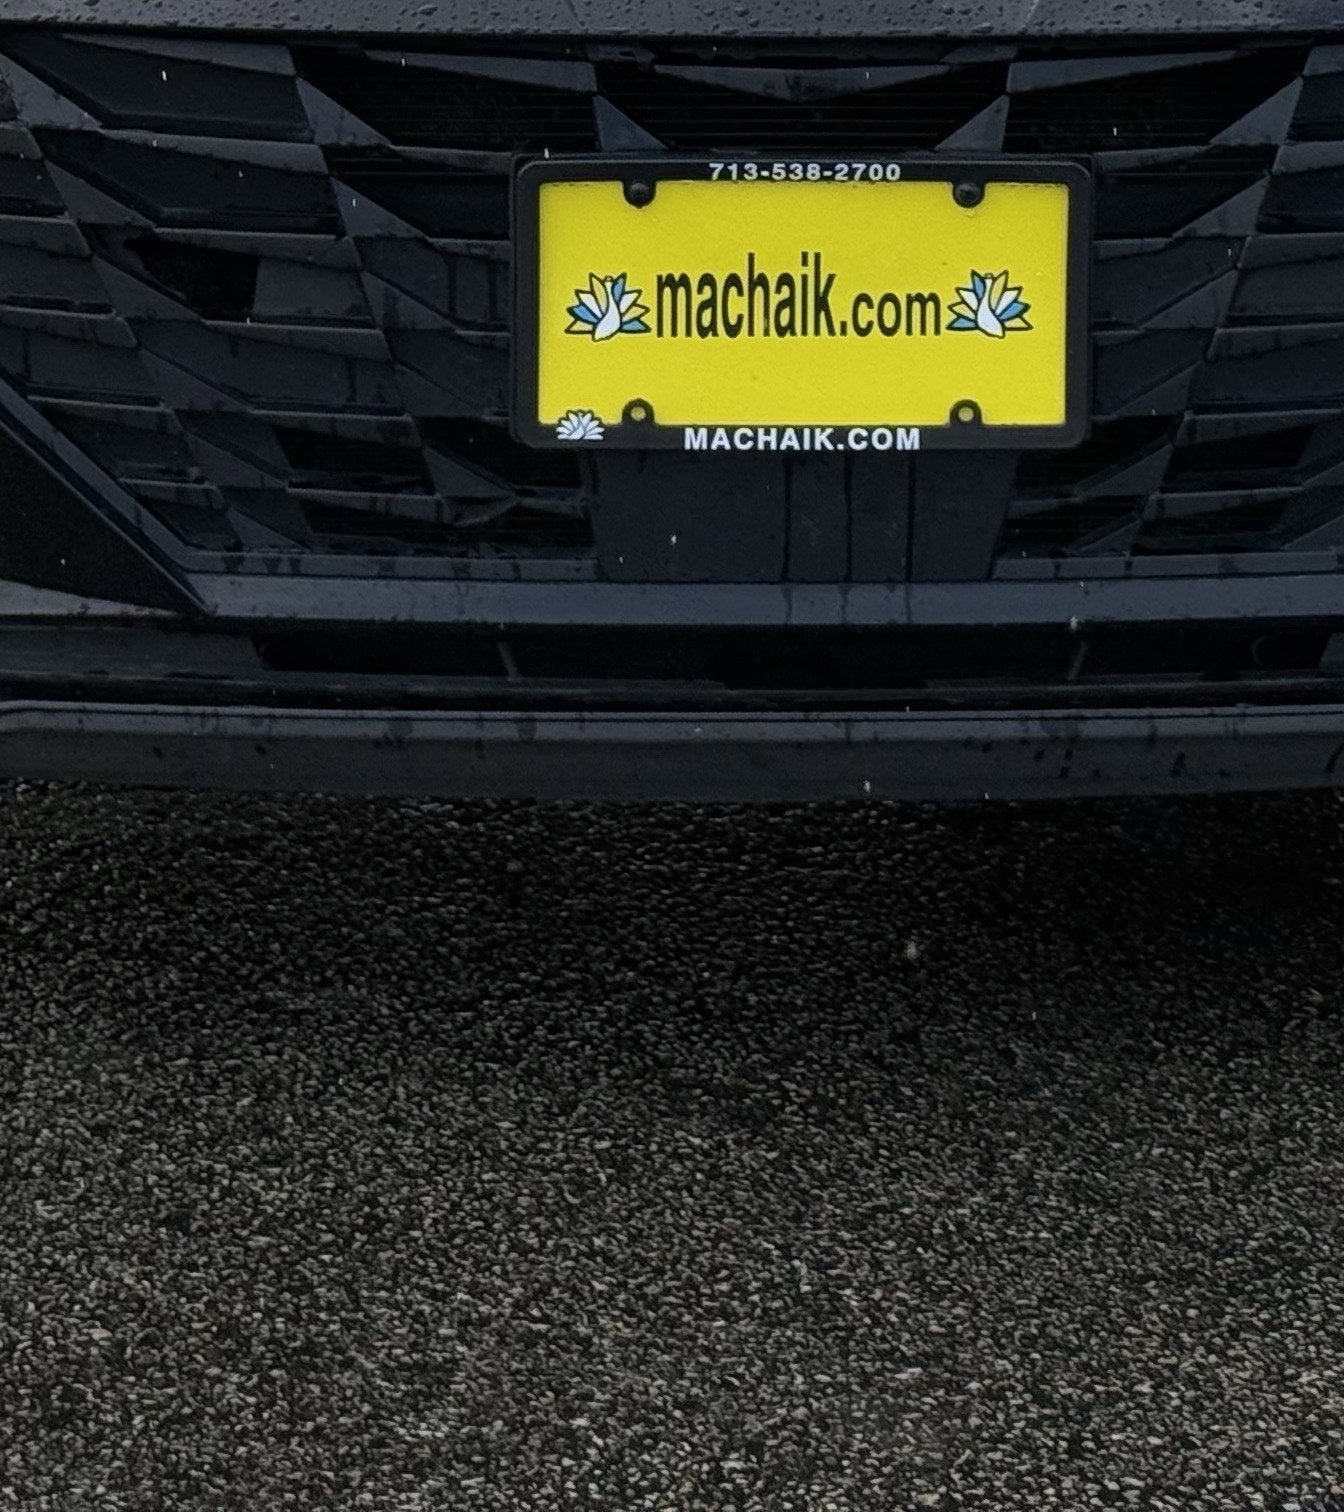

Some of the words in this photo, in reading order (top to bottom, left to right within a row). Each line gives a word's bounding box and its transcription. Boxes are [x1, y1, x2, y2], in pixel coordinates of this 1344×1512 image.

[709, 162, 901, 181] 713-538-2700
[656, 251, 942, 339] machaik.com
[684, 427, 921, 451] MACHAIK.COM
